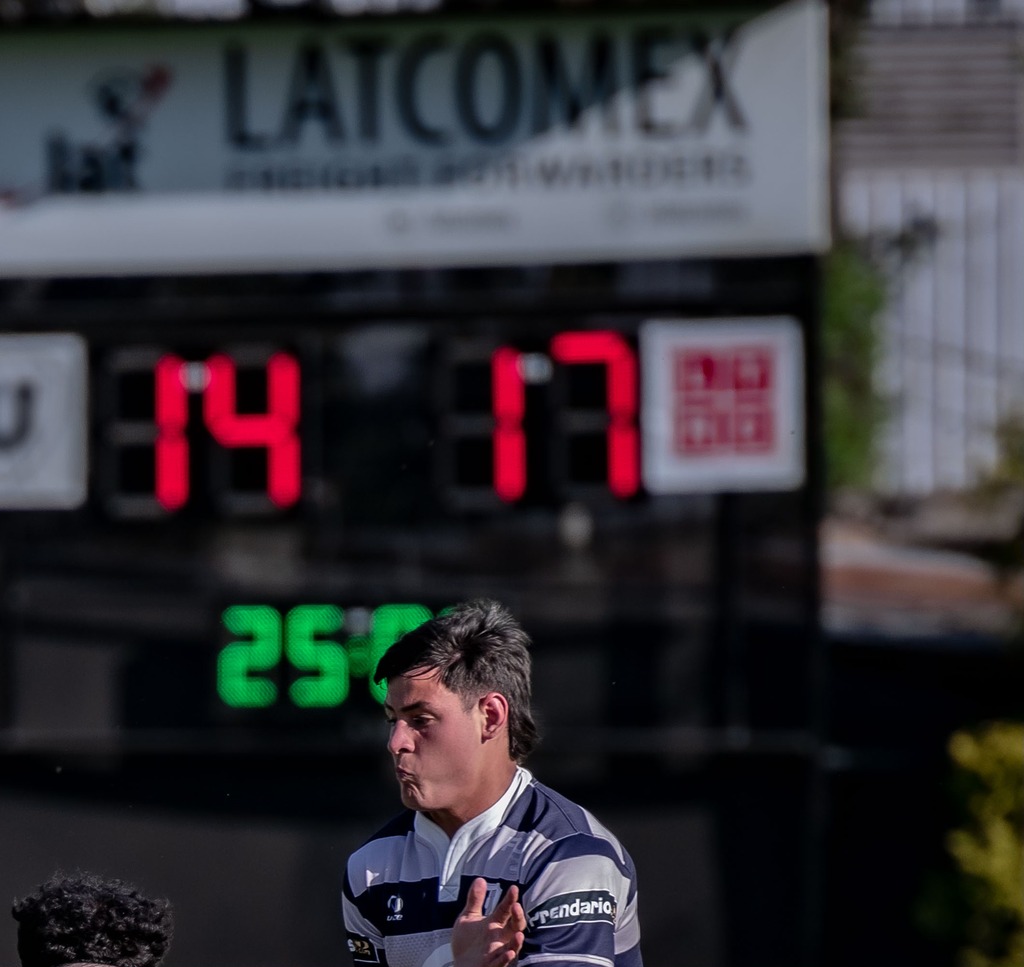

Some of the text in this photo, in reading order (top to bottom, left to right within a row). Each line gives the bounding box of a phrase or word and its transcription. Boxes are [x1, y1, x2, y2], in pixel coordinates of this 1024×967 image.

[223, 29, 748, 150] LATCOMEX
[154, 353, 302, 511] 14
[492, 331, 639, 502] 17
[217, 604, 436, 708] 25:
[529, 897, 613, 927] Prendario
